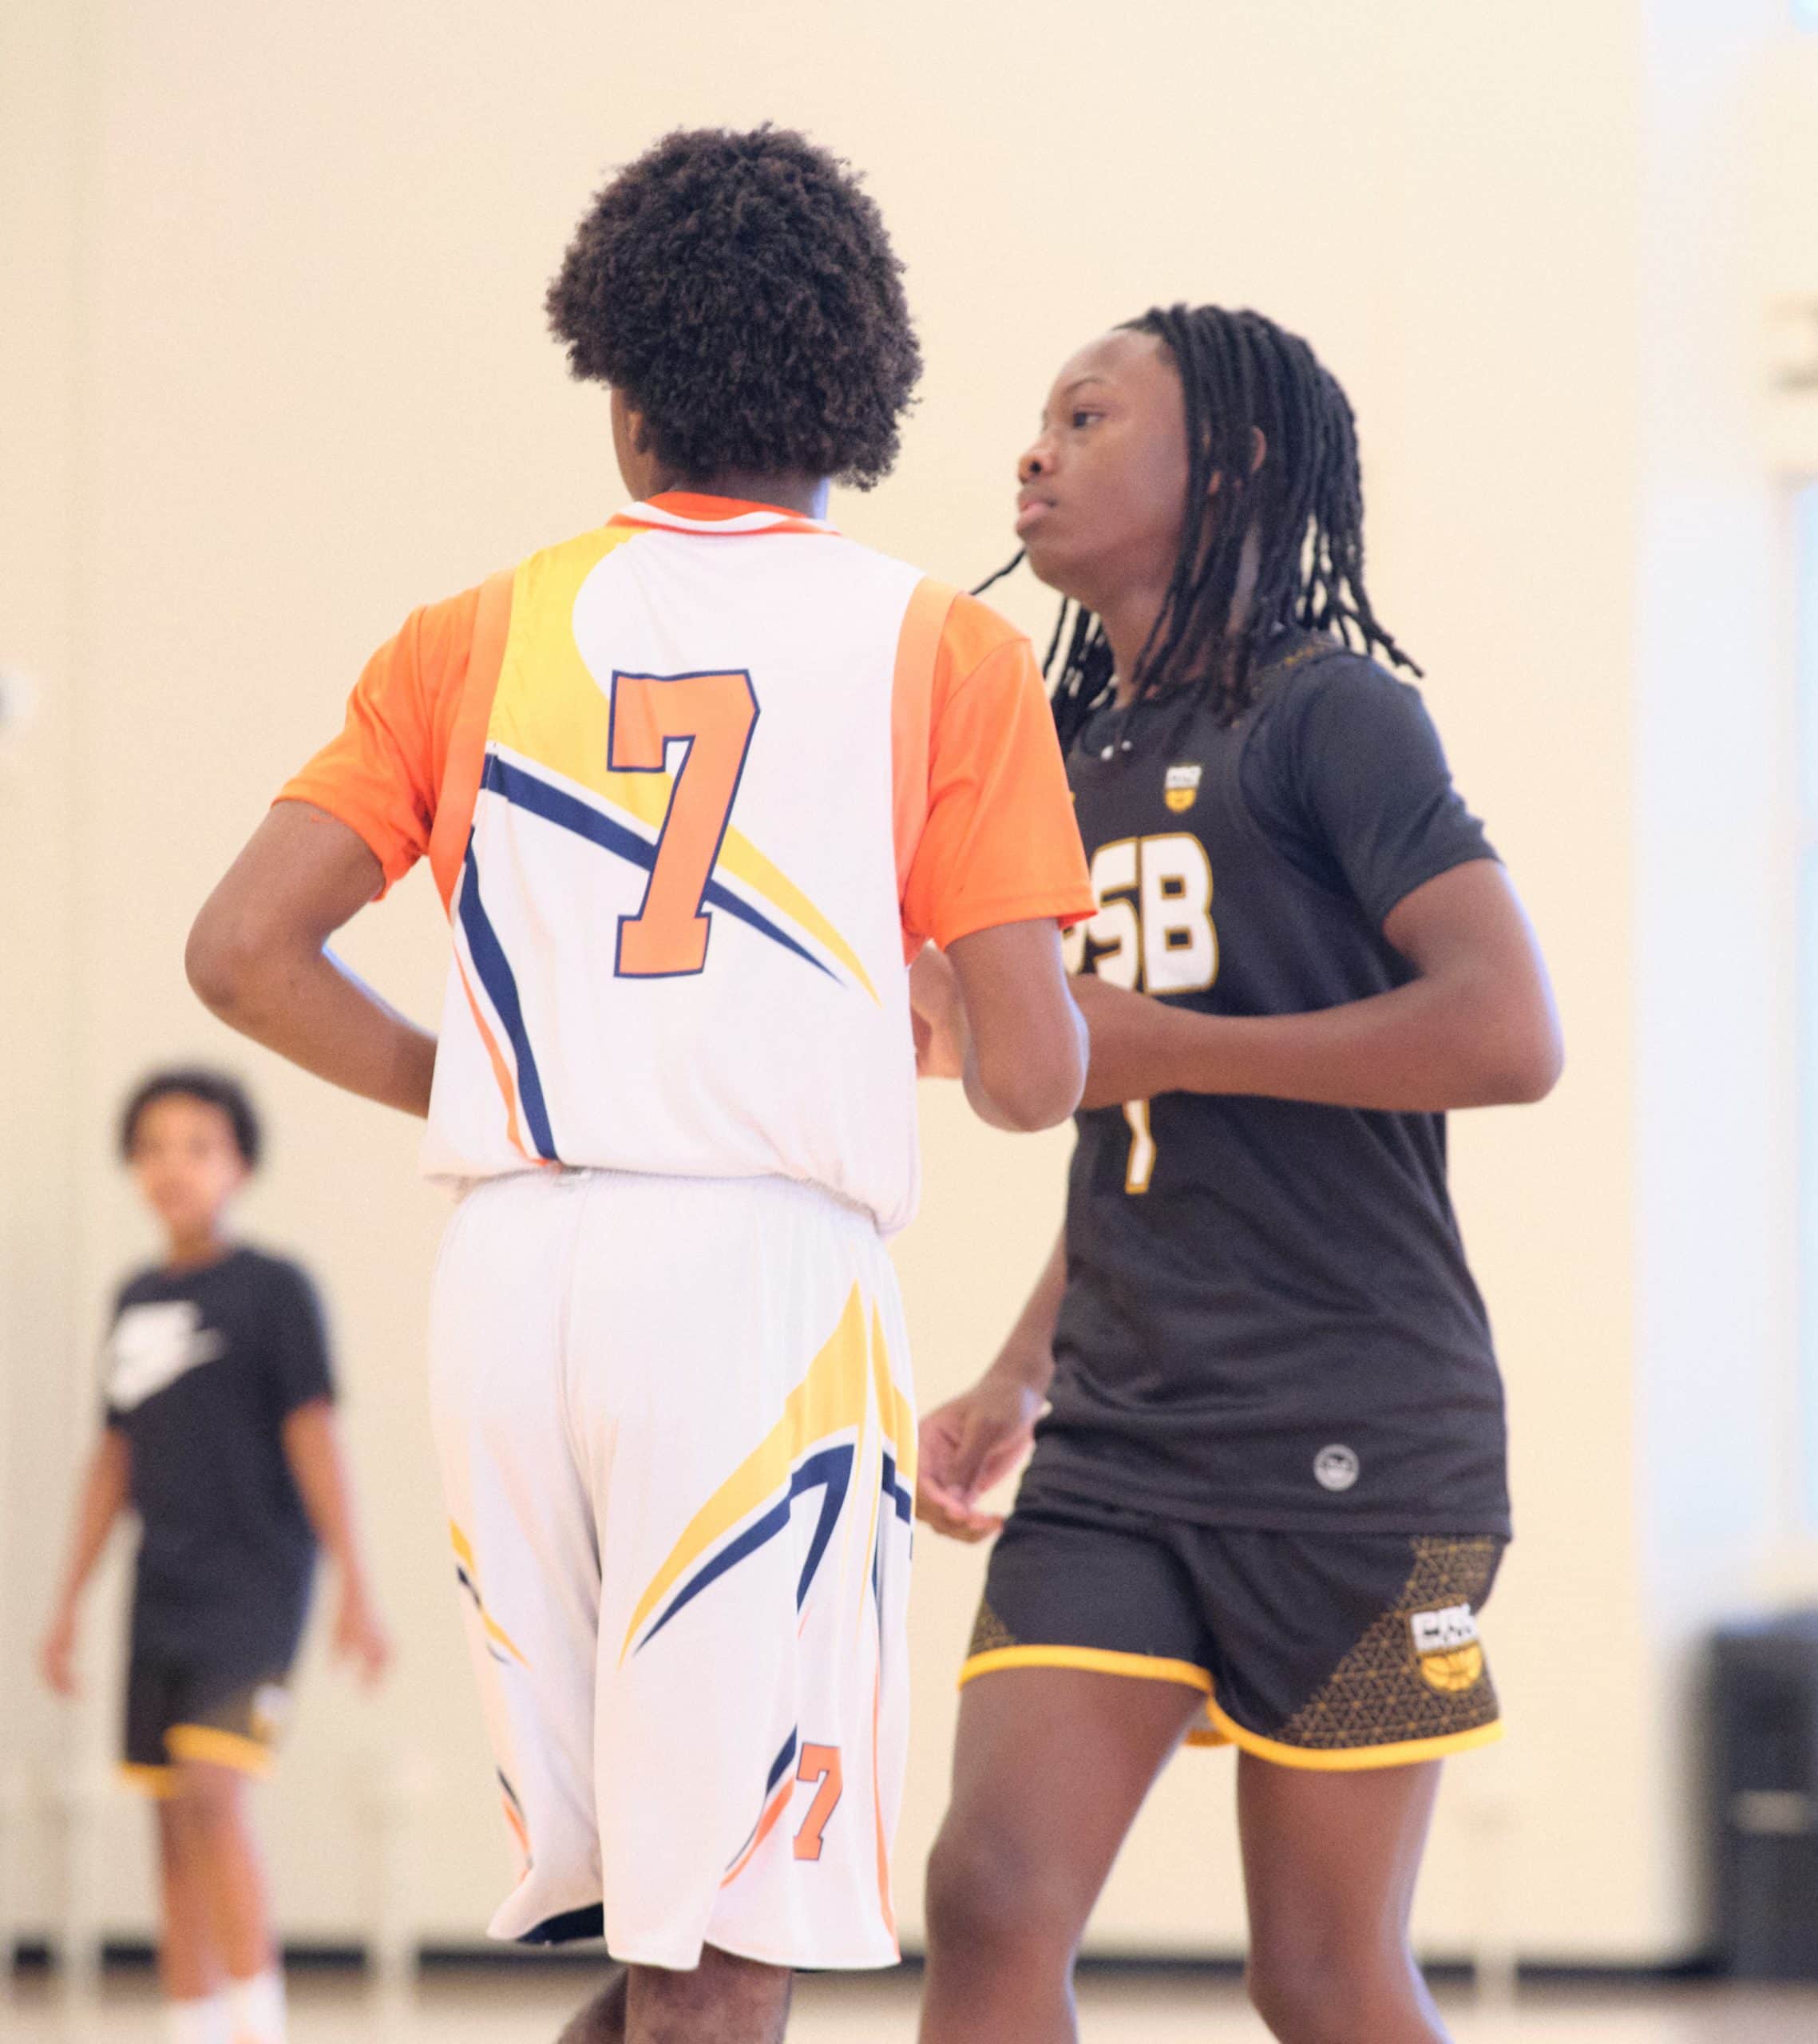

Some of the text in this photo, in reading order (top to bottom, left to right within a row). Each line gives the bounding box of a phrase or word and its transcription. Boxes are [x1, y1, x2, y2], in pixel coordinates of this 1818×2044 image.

[607, 668, 761, 980] 7
[1060, 831, 1219, 996] SB
[793, 1741, 843, 1861] 7
